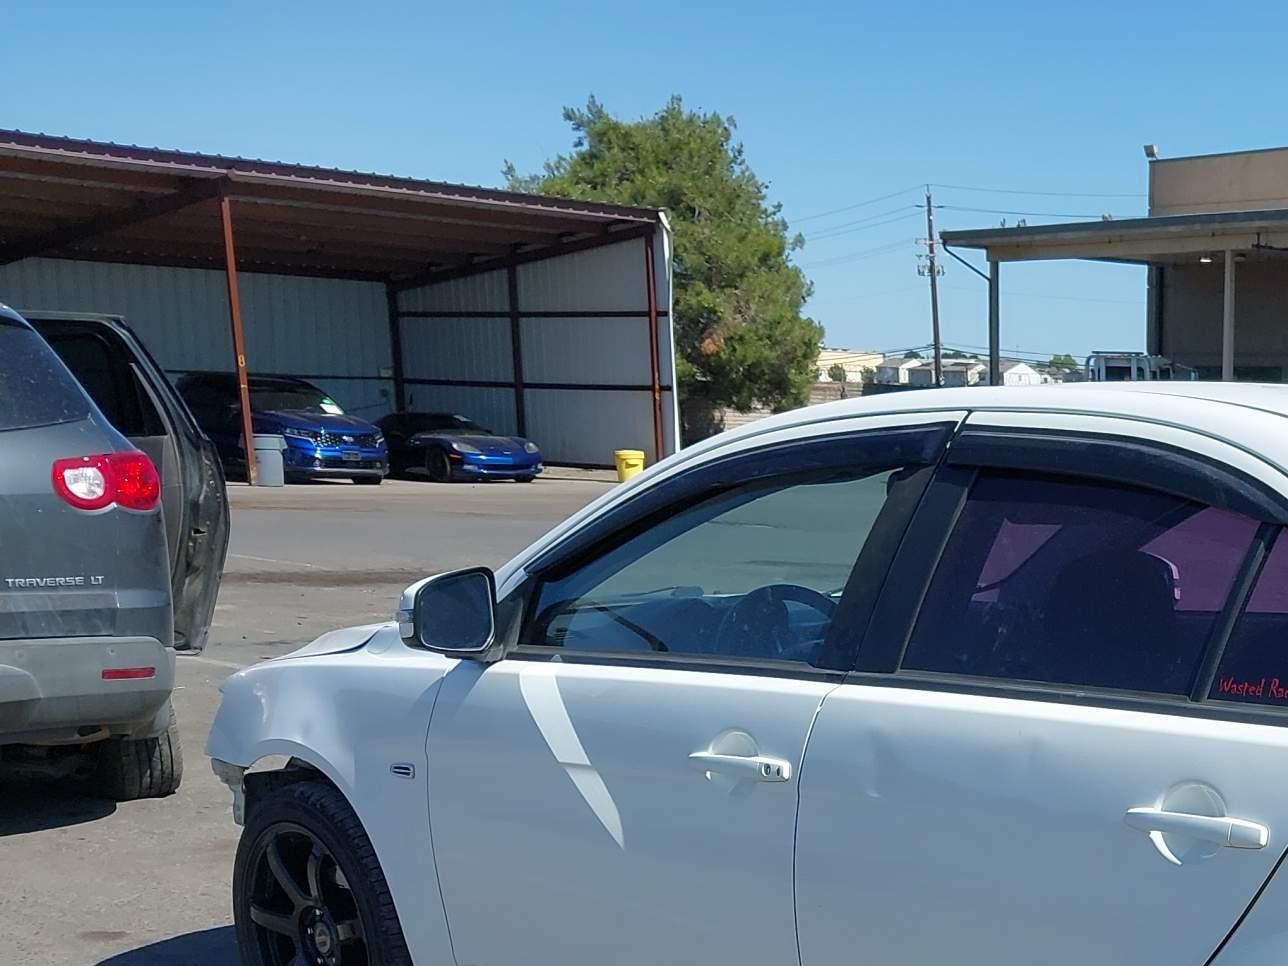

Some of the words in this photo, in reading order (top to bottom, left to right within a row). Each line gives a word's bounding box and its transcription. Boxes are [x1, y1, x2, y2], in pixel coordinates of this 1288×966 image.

[5, 576, 84, 588] TRAVERSE
[90, 575, 105, 585] LT
[1218, 676, 1265, 697] Wasted
